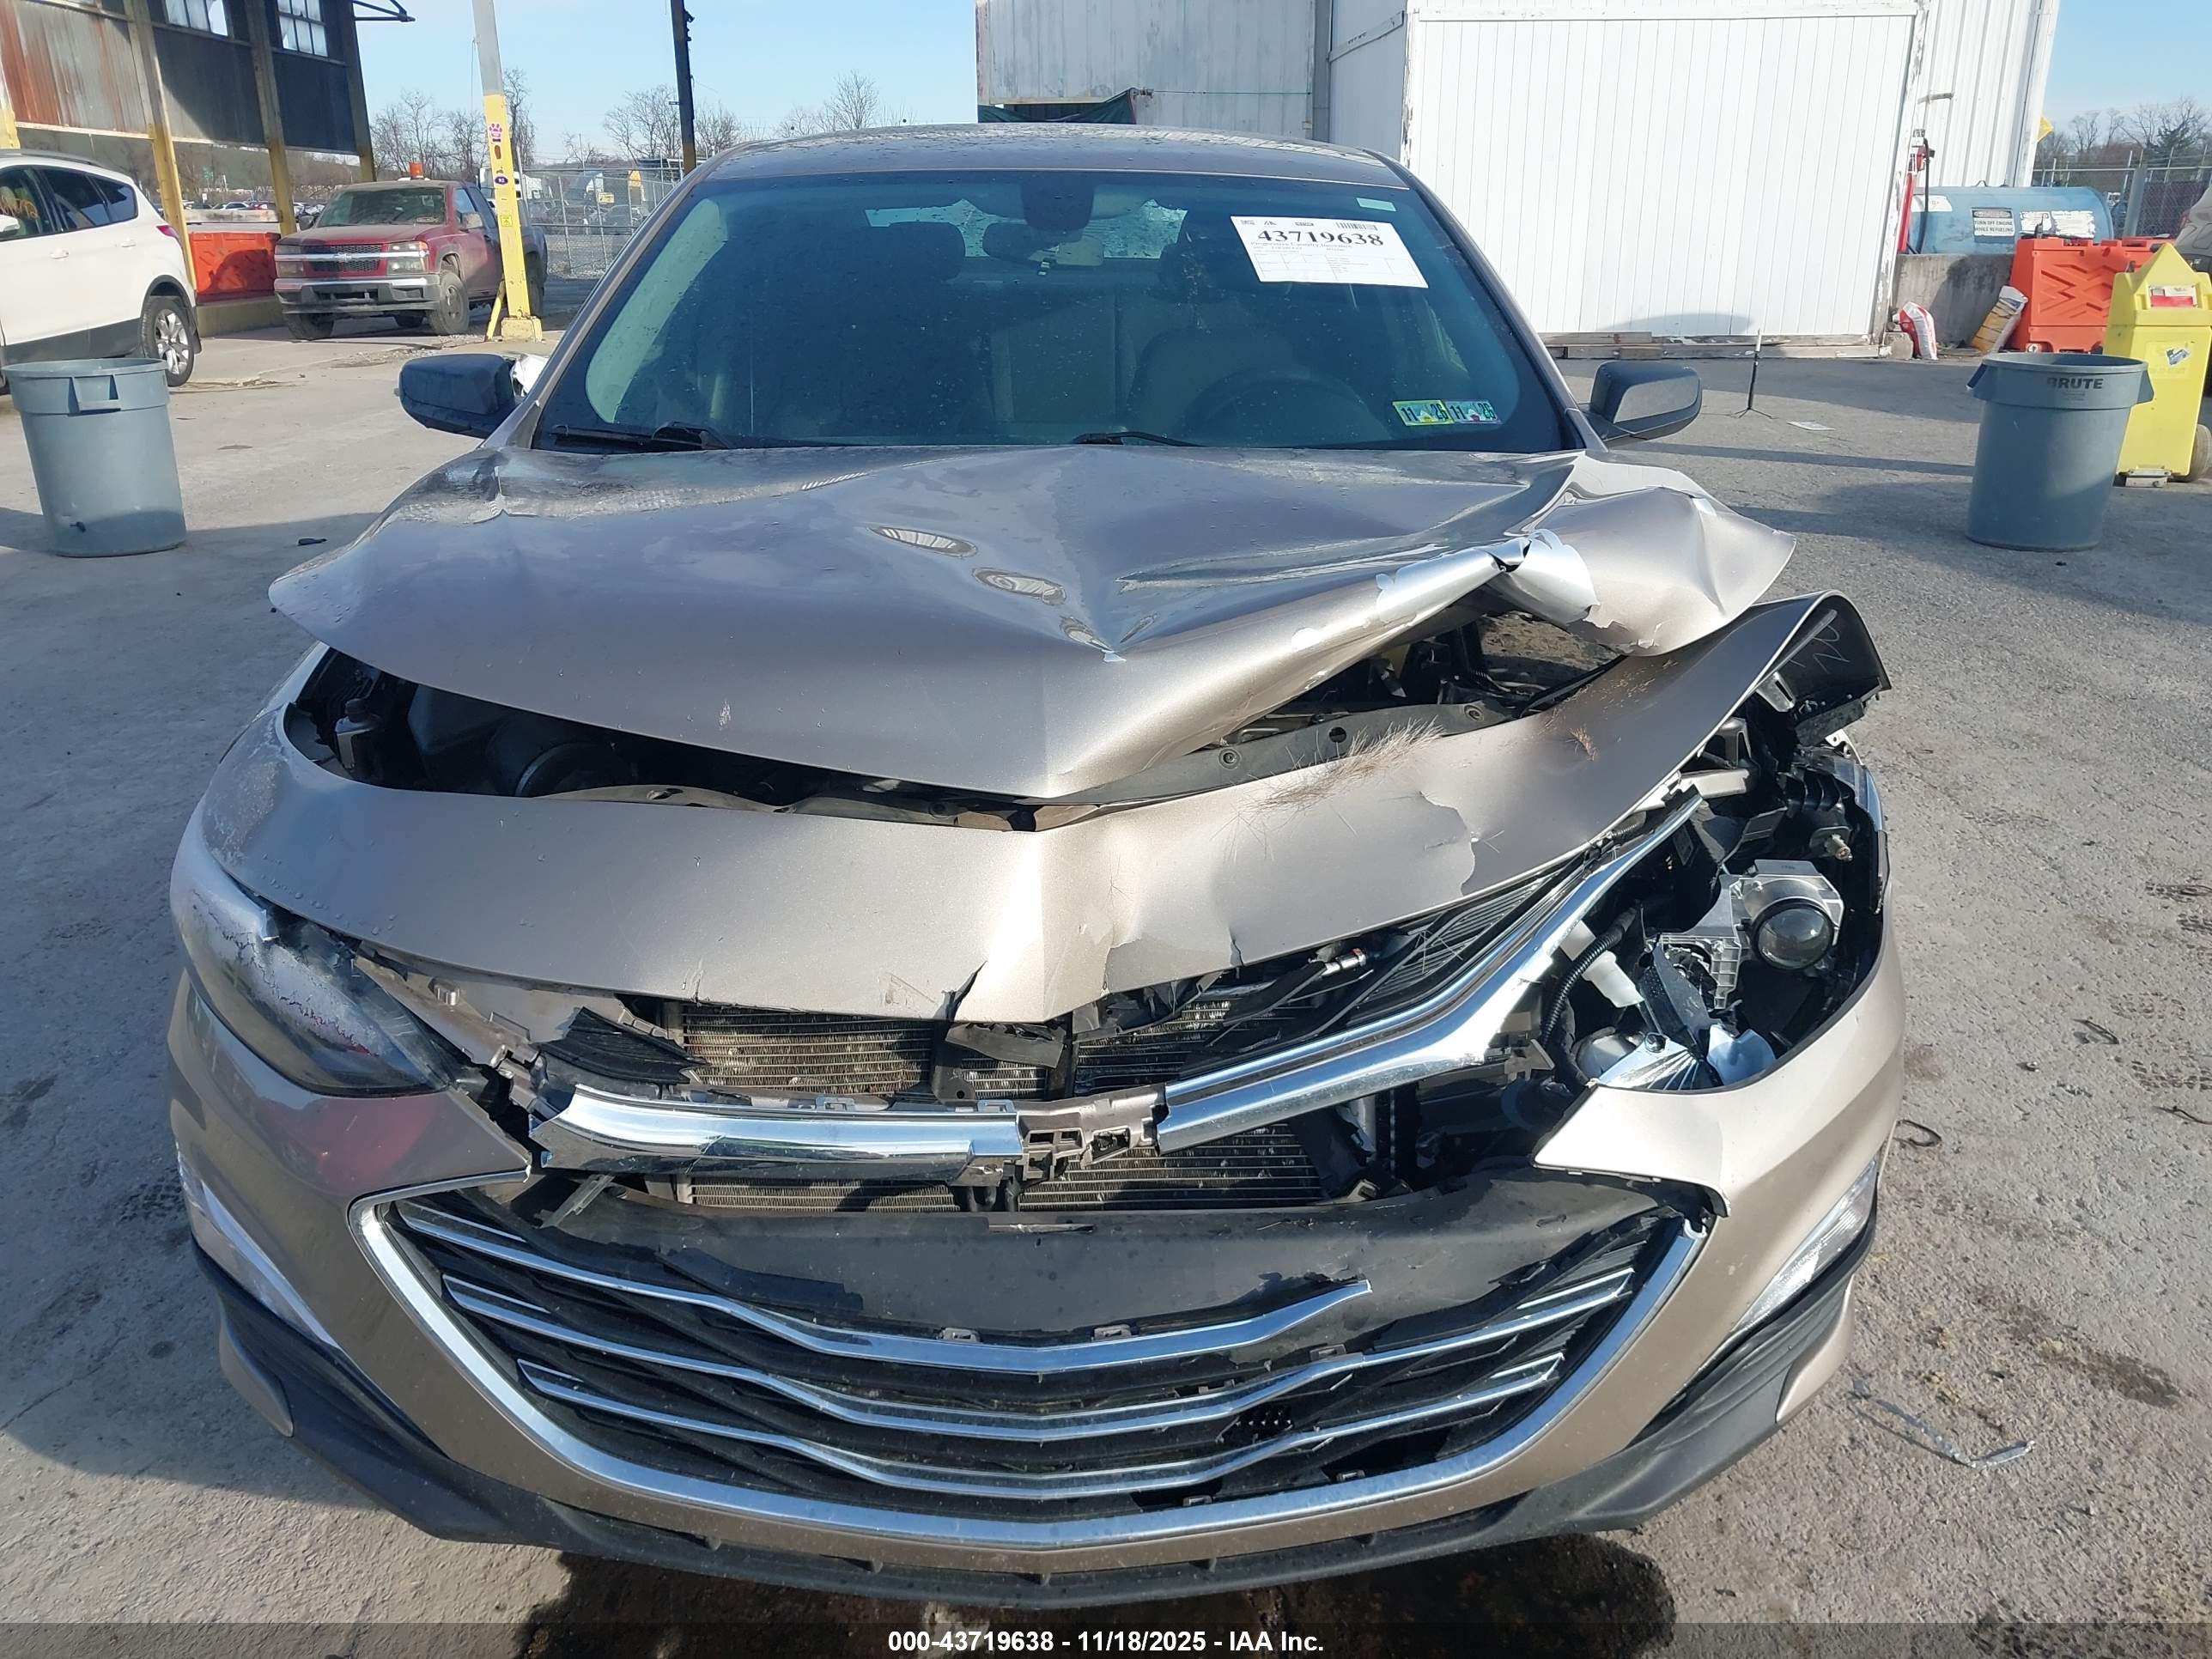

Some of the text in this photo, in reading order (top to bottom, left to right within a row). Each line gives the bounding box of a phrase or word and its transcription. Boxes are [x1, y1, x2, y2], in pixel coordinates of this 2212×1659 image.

[1258, 229, 1383, 246] 43719638
[2047, 377, 2104, 390] BRUTE
[1401, 406, 1419, 422] 11
[1450, 404, 1468, 420] 11
